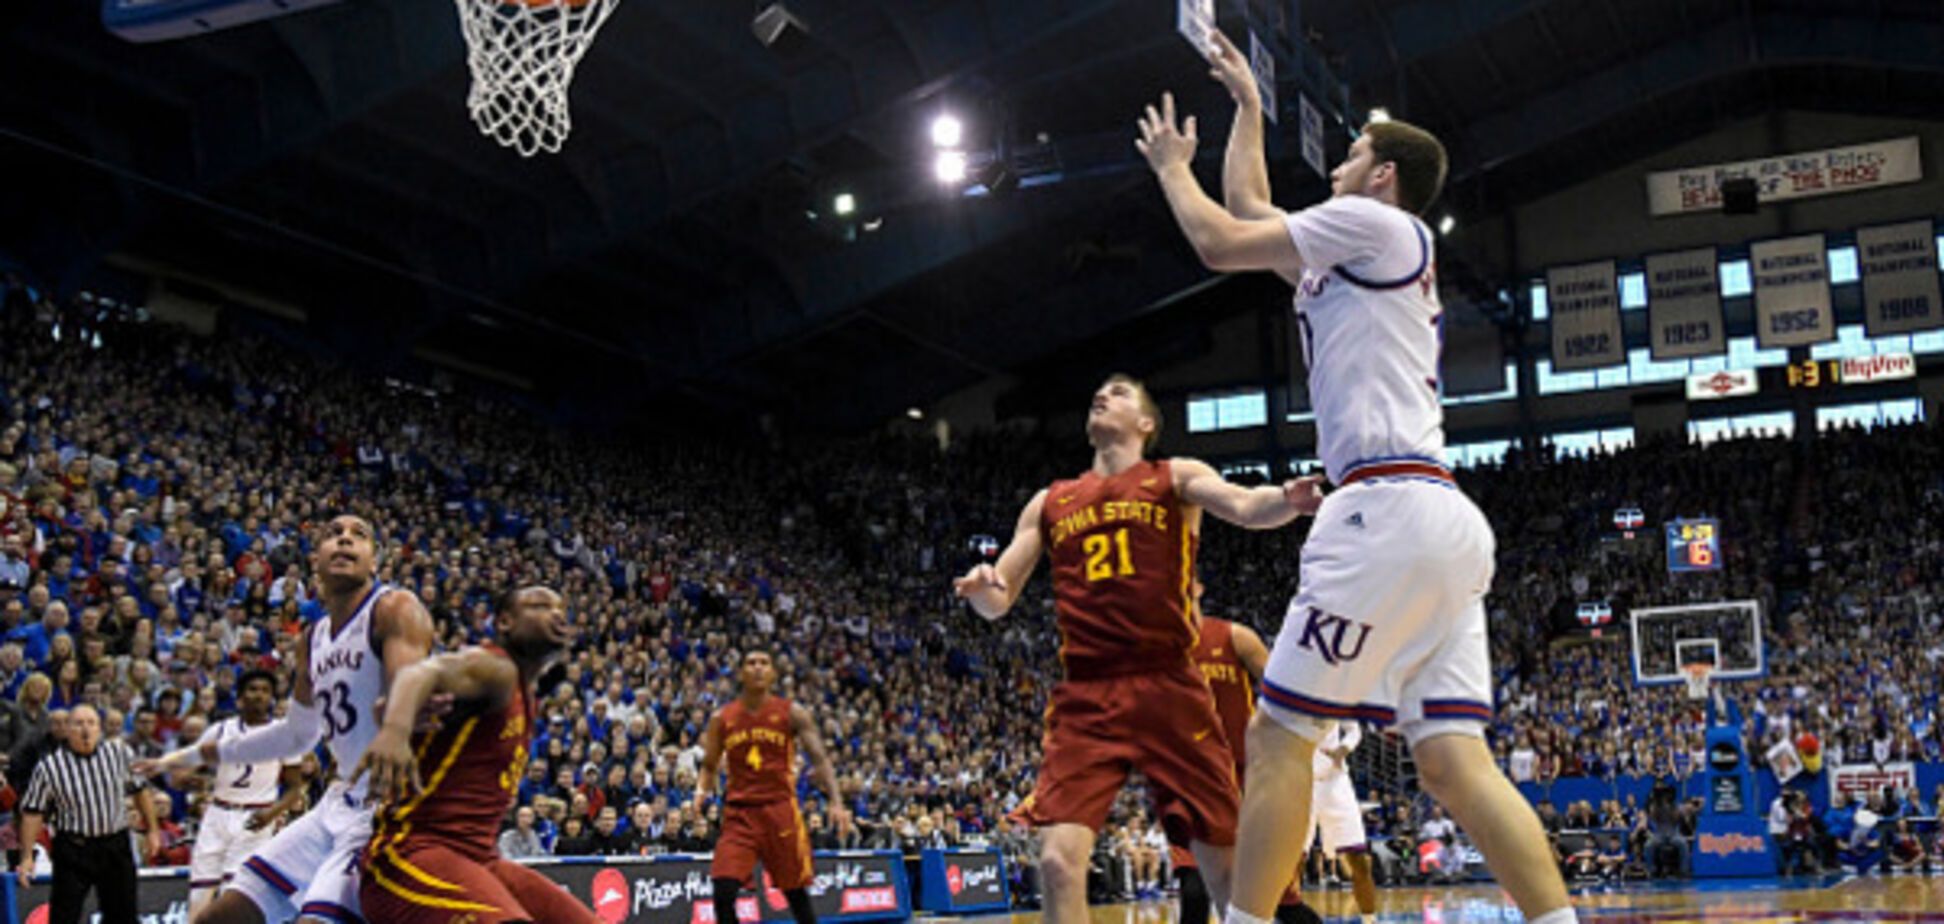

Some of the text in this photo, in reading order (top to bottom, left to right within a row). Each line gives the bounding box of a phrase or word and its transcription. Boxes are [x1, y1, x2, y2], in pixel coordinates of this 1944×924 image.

[1664, 321, 1711, 345] 1923
[1770, 307, 1820, 334] 1952
[1565, 333, 1610, 357] 1922
[1103, 500, 1169, 530] STATE
[1083, 528, 1135, 581] 21
[1689, 541, 1712, 565] 6
[1297, 606, 1374, 668] KU
[317, 680, 358, 740] 33
[746, 744, 762, 772] 4
[231, 763, 253, 789] 2
[1837, 770, 1910, 793] ESPN
[633, 876, 683, 915] Pizza
